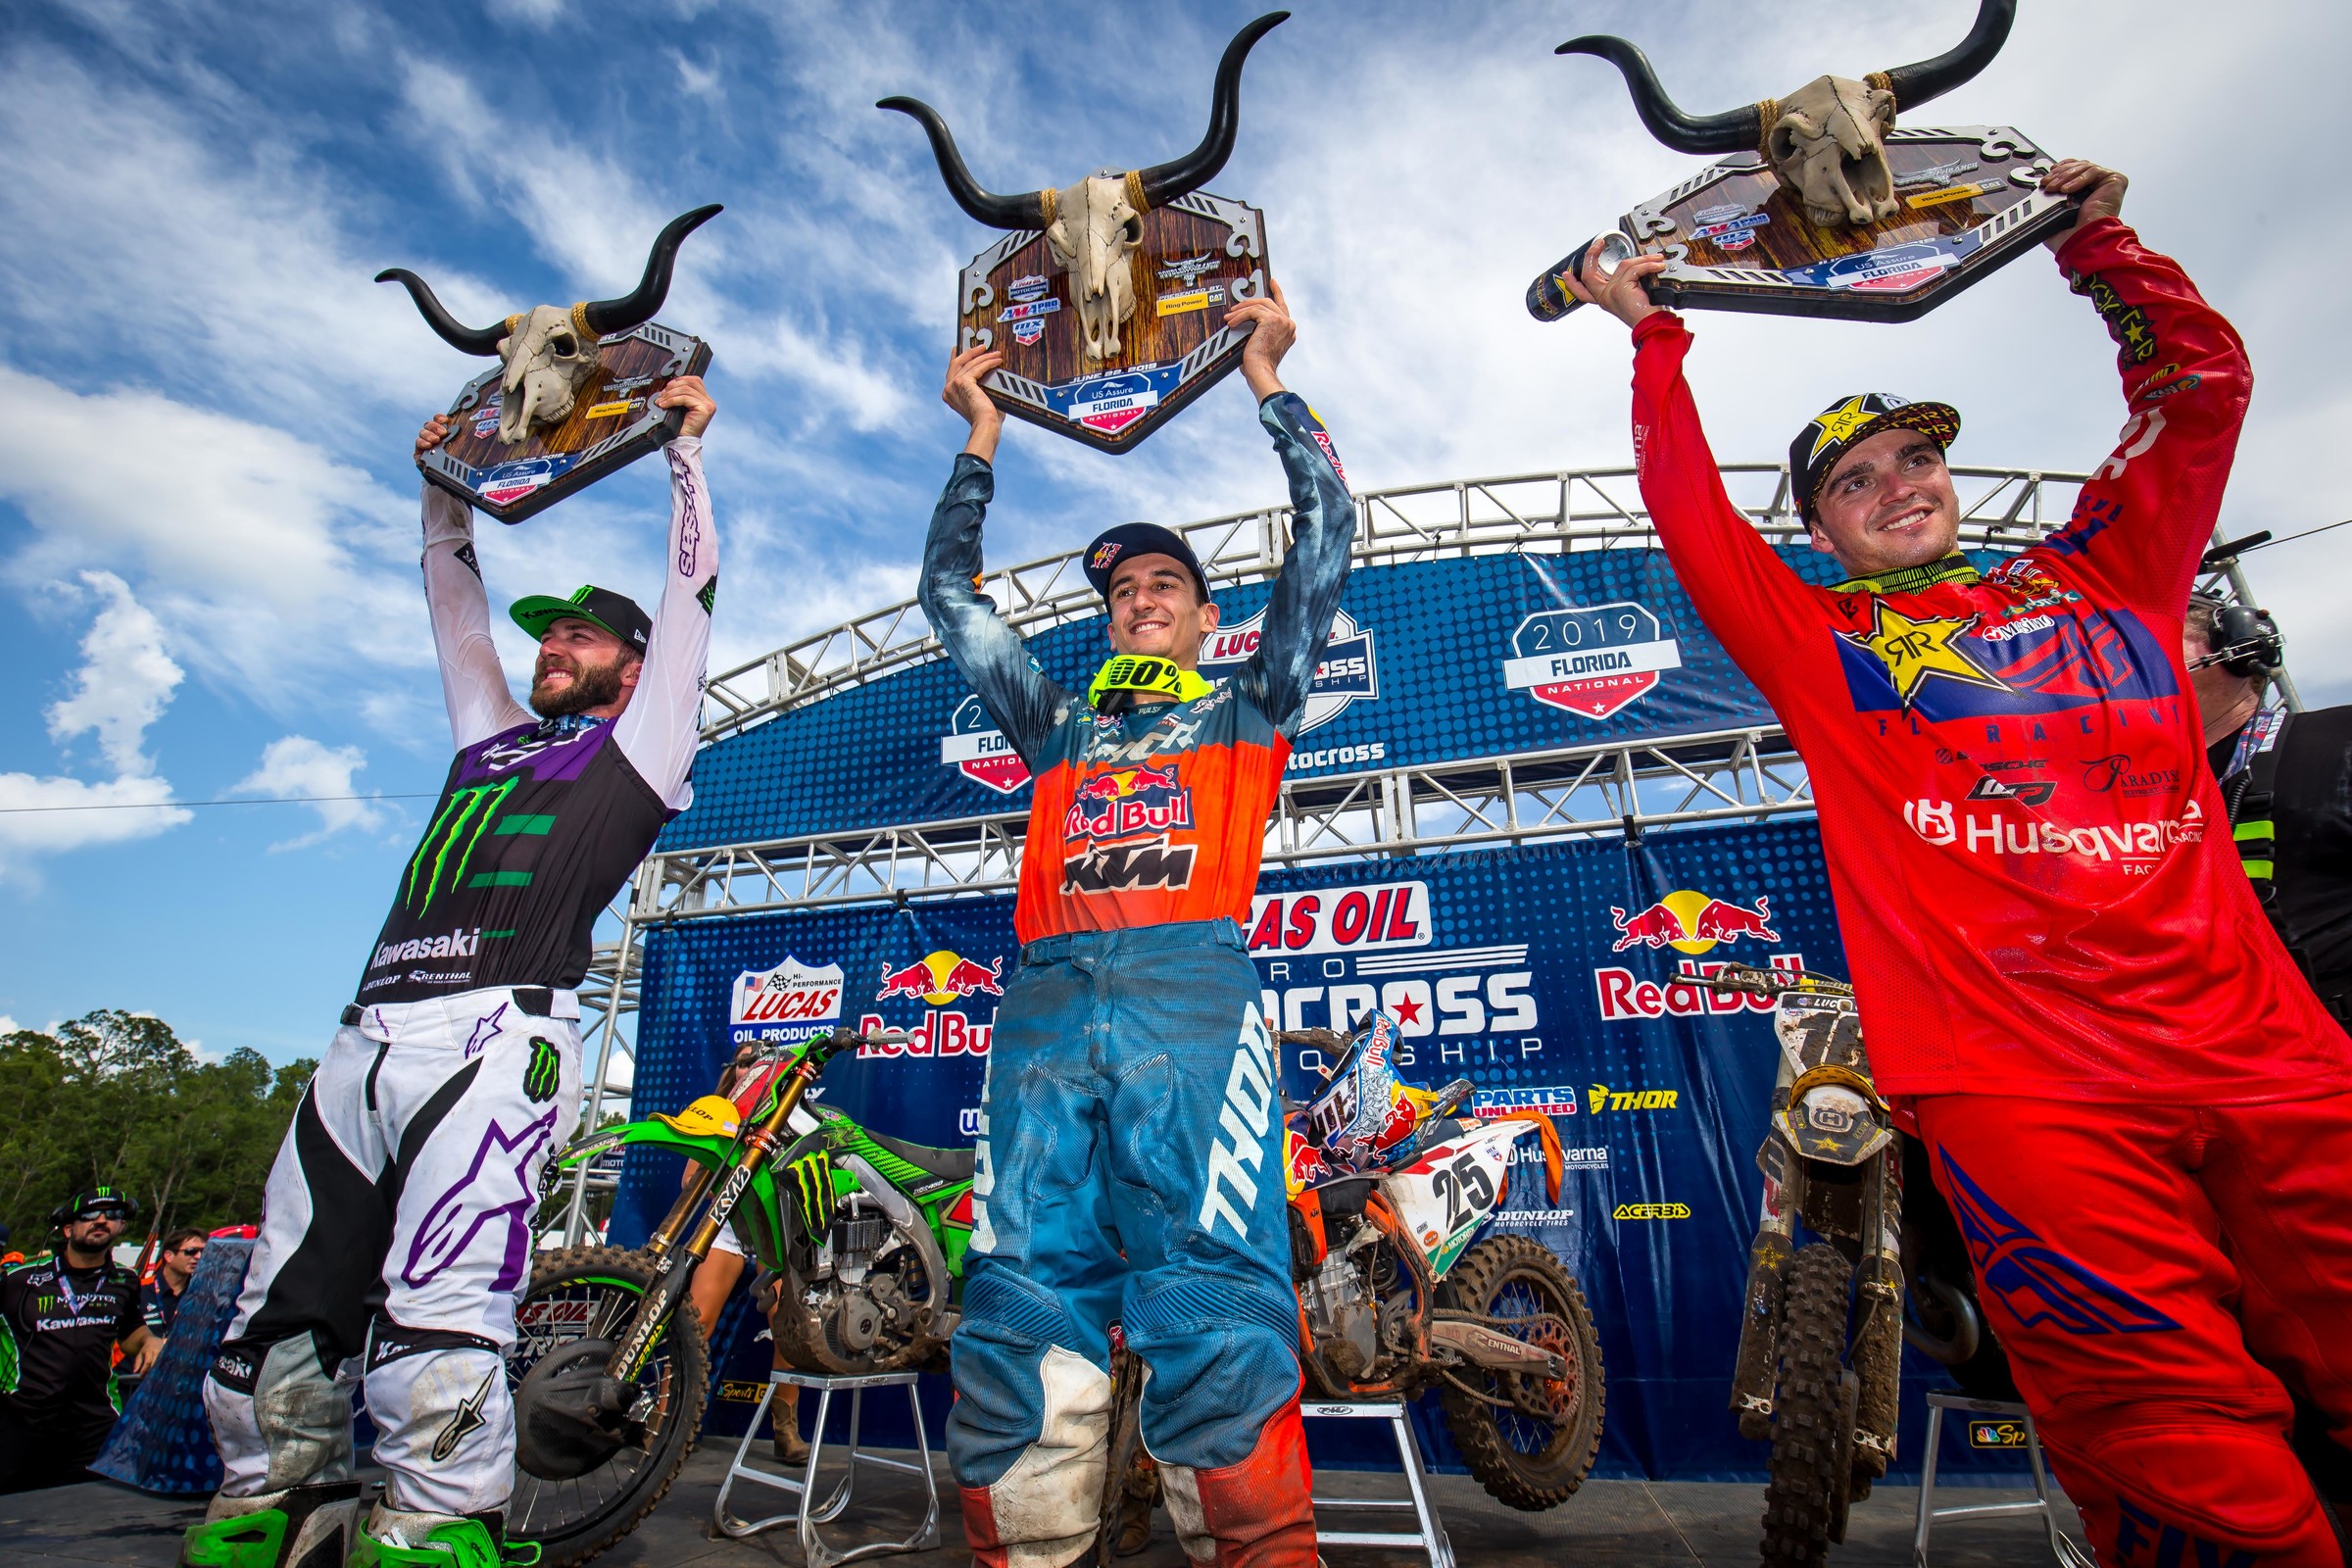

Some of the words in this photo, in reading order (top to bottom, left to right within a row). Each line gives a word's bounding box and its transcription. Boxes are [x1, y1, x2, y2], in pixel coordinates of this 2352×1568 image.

[1982, 180, 2001, 189] CAT
[1740, 214, 1767, 224] PRO
[1694, 221, 1740, 237] AMA
[1855, 261, 1873, 270] US
[1876, 255, 1916, 268] Assure
[1862, 262, 1923, 279] FLORIDA
[1861, 269, 1935, 286] NATIONAL
[1039, 299, 1058, 311] PRO
[1181, 298, 1202, 307] Power
[1208, 293, 1224, 303] CAT
[1002, 304, 1038, 321] AMA
[1069, 371, 1102, 384] JUNE
[1127, 362, 1157, 373] 2019
[1092, 391, 1104, 400] US
[1104, 386, 1134, 397] Assure
[1092, 397, 1134, 413] FLORIDA
[1089, 409, 1139, 421] NATIONAL
[514, 468, 536, 478] Assure
[497, 477, 531, 489] FLORIDA
[1533, 613, 1638, 651] 2019
[1550, 651, 1633, 677] FLORIDA
[1547, 675, 1645, 695] NATIONAL
[1063, 801, 1117, 839] Red
[1120, 790, 1190, 833] Bull
[1059, 833, 1199, 896] KTM
[1331, 886, 1420, 946] OIL
[369, 926, 481, 971] Kawasaki
[362, 974, 402, 993] DUNLOP
[420, 970, 472, 981] RENTHAL
[792, 977, 843, 988] PERFORMANCE
[1594, 959, 1705, 1021] Red
[741, 988, 839, 1021] LUCAS
[734, 1029, 758, 1045] OIL
[761, 1024, 835, 1043] PRODUCTS
[857, 1010, 937, 1059] Red
[1472, 1086, 1570, 1108] PARTS
[1608, 1090, 1679, 1111] THOR
[1564, 1162, 1609, 1171] MOTORCYCLES
[1432, 1152, 1494, 1235] 25
[1495, 1208, 1575, 1222] DUNLOP
[1613, 1203, 1691, 1220] ACERBIS
[1494, 1219, 1544, 1228] MOTORCYCLE
[1545, 1218, 1569, 1227] TIRES
[1447, 1225, 1477, 1251] MOTOREX
[36, 1315, 117, 1332] Kawasaki
[614, 1289, 668, 1381] DUNLOP
[721, 1383, 756, 1400] Sports
